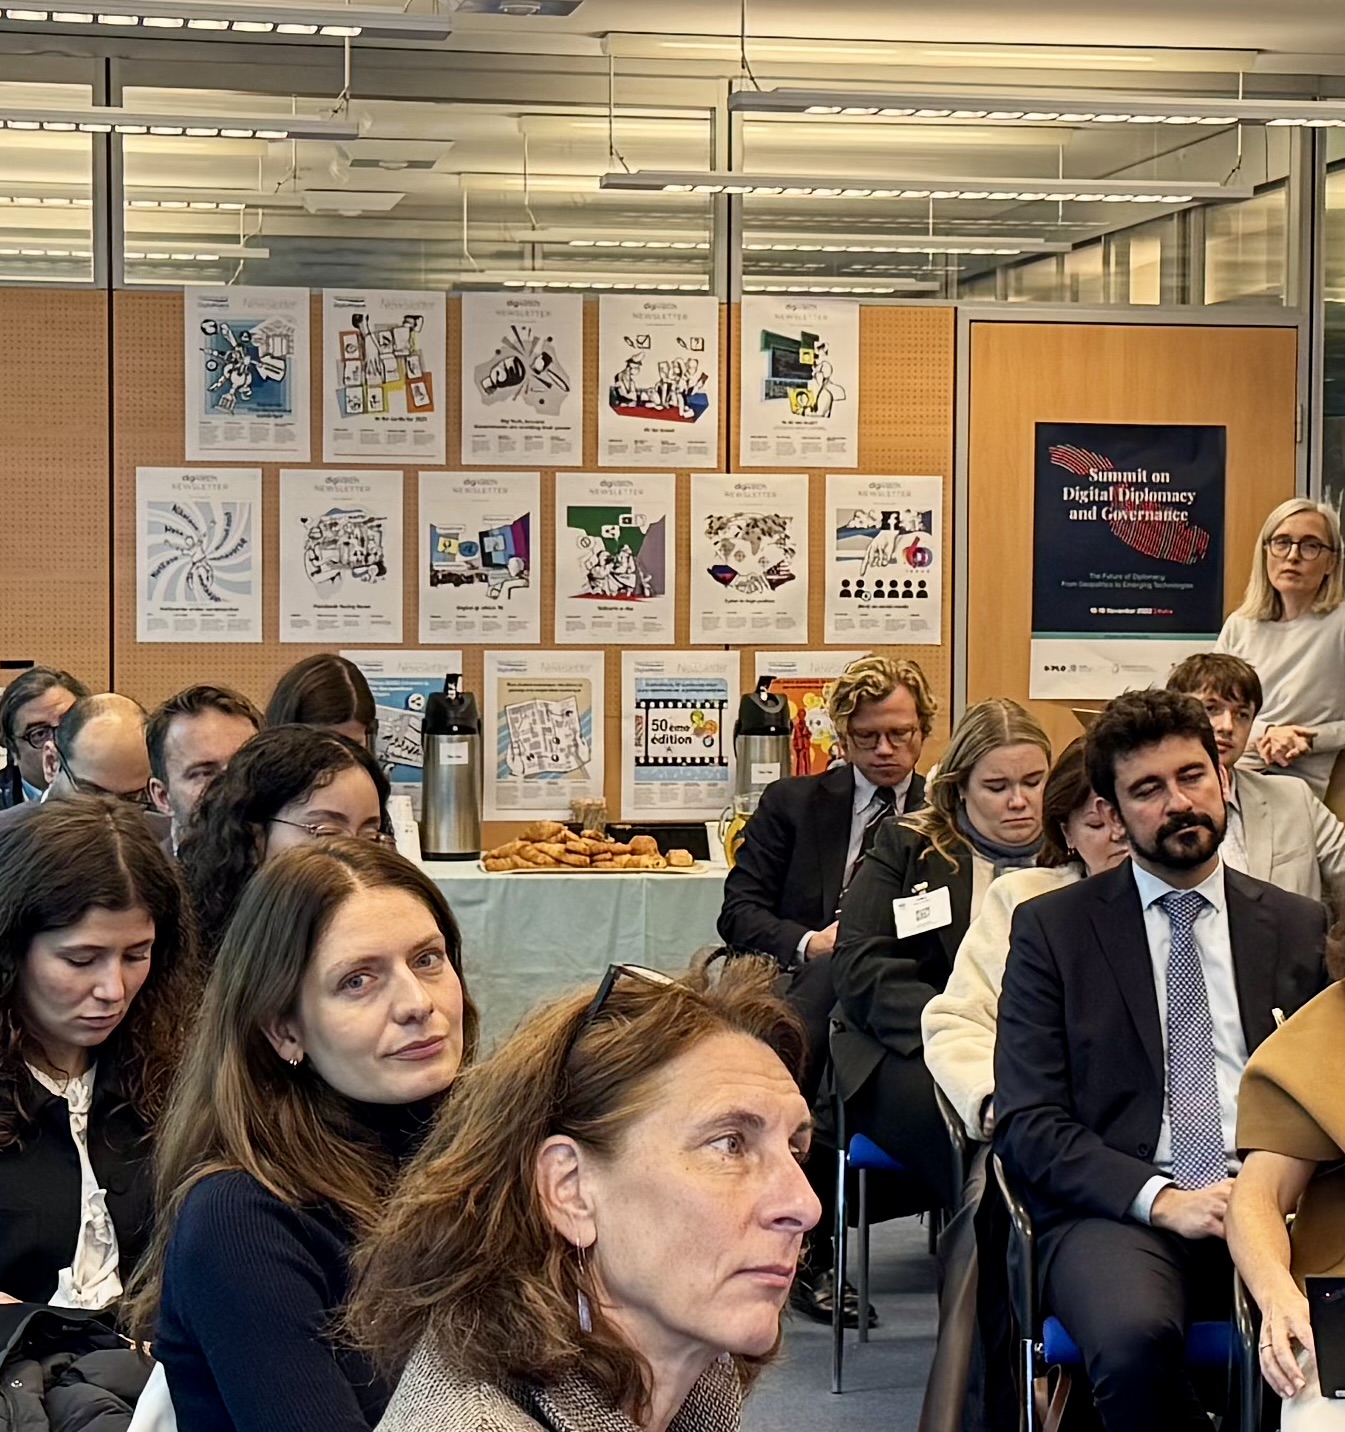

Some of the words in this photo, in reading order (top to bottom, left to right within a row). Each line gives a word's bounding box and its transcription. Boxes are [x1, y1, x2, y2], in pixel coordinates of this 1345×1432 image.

[1089, 468, 1147, 483] Summit
[1151, 472, 1170, 483] on
[1063, 486, 1114, 503] Digital
[1118, 487, 1196, 505] Diplomacy
[1069, 506, 1097, 520] and
[1101, 506, 1189, 522] Governance
